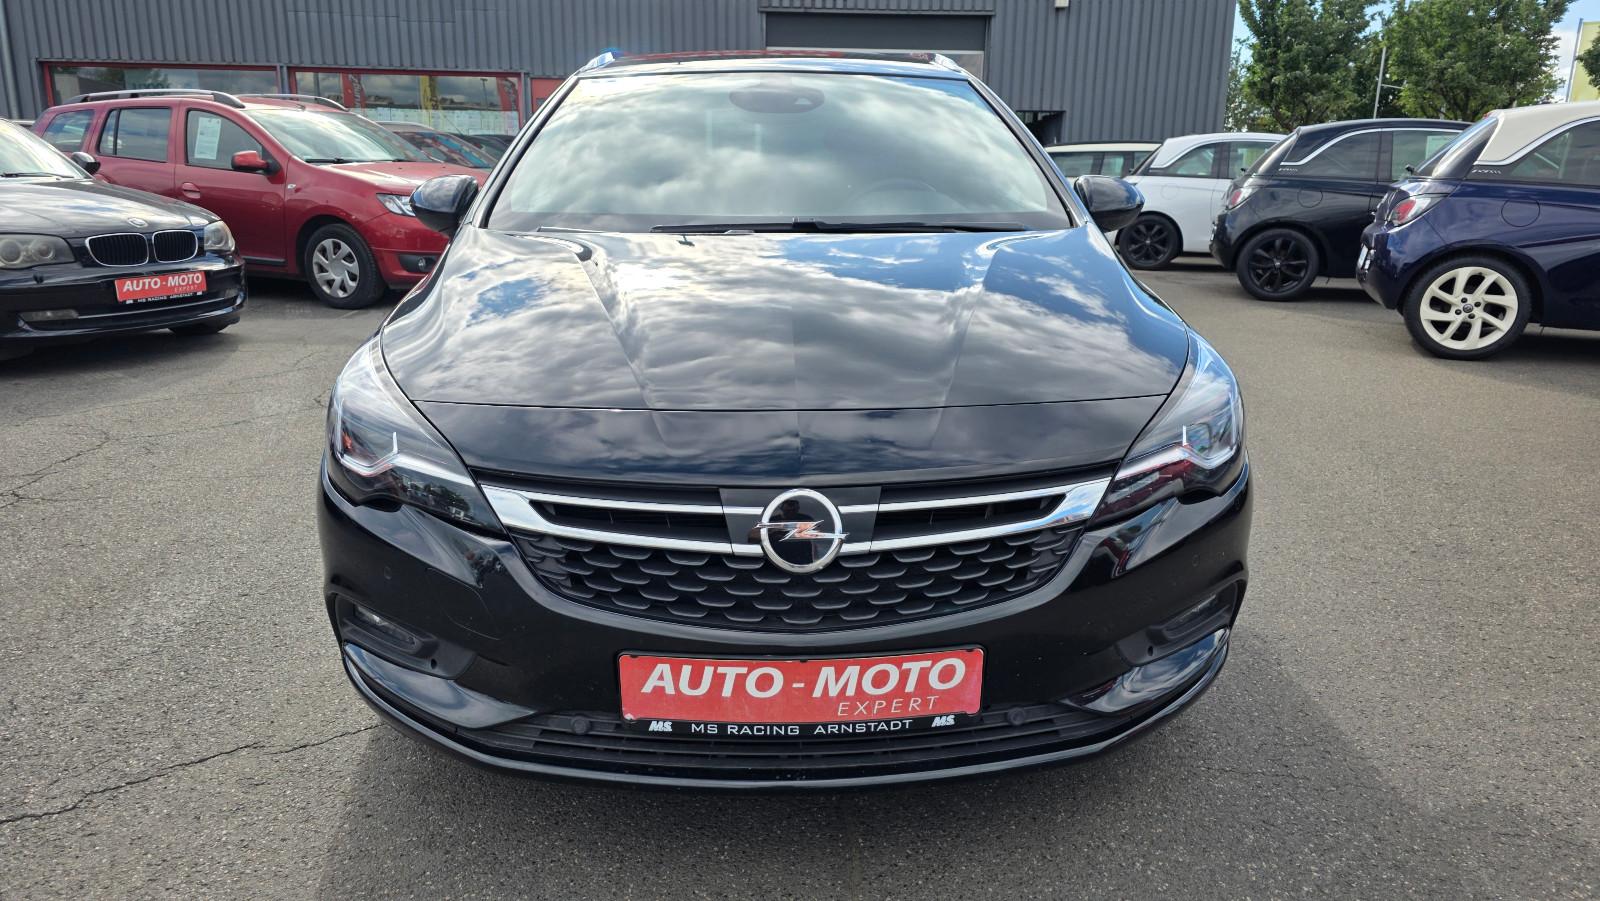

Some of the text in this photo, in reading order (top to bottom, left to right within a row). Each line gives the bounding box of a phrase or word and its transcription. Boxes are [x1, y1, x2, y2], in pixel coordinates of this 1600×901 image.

[837, 695, 940, 717] EXPERT
[691, 723, 718, 734] MS
[727, 724, 800, 736] RACING
[814, 719, 914, 735] ARNSTADT
